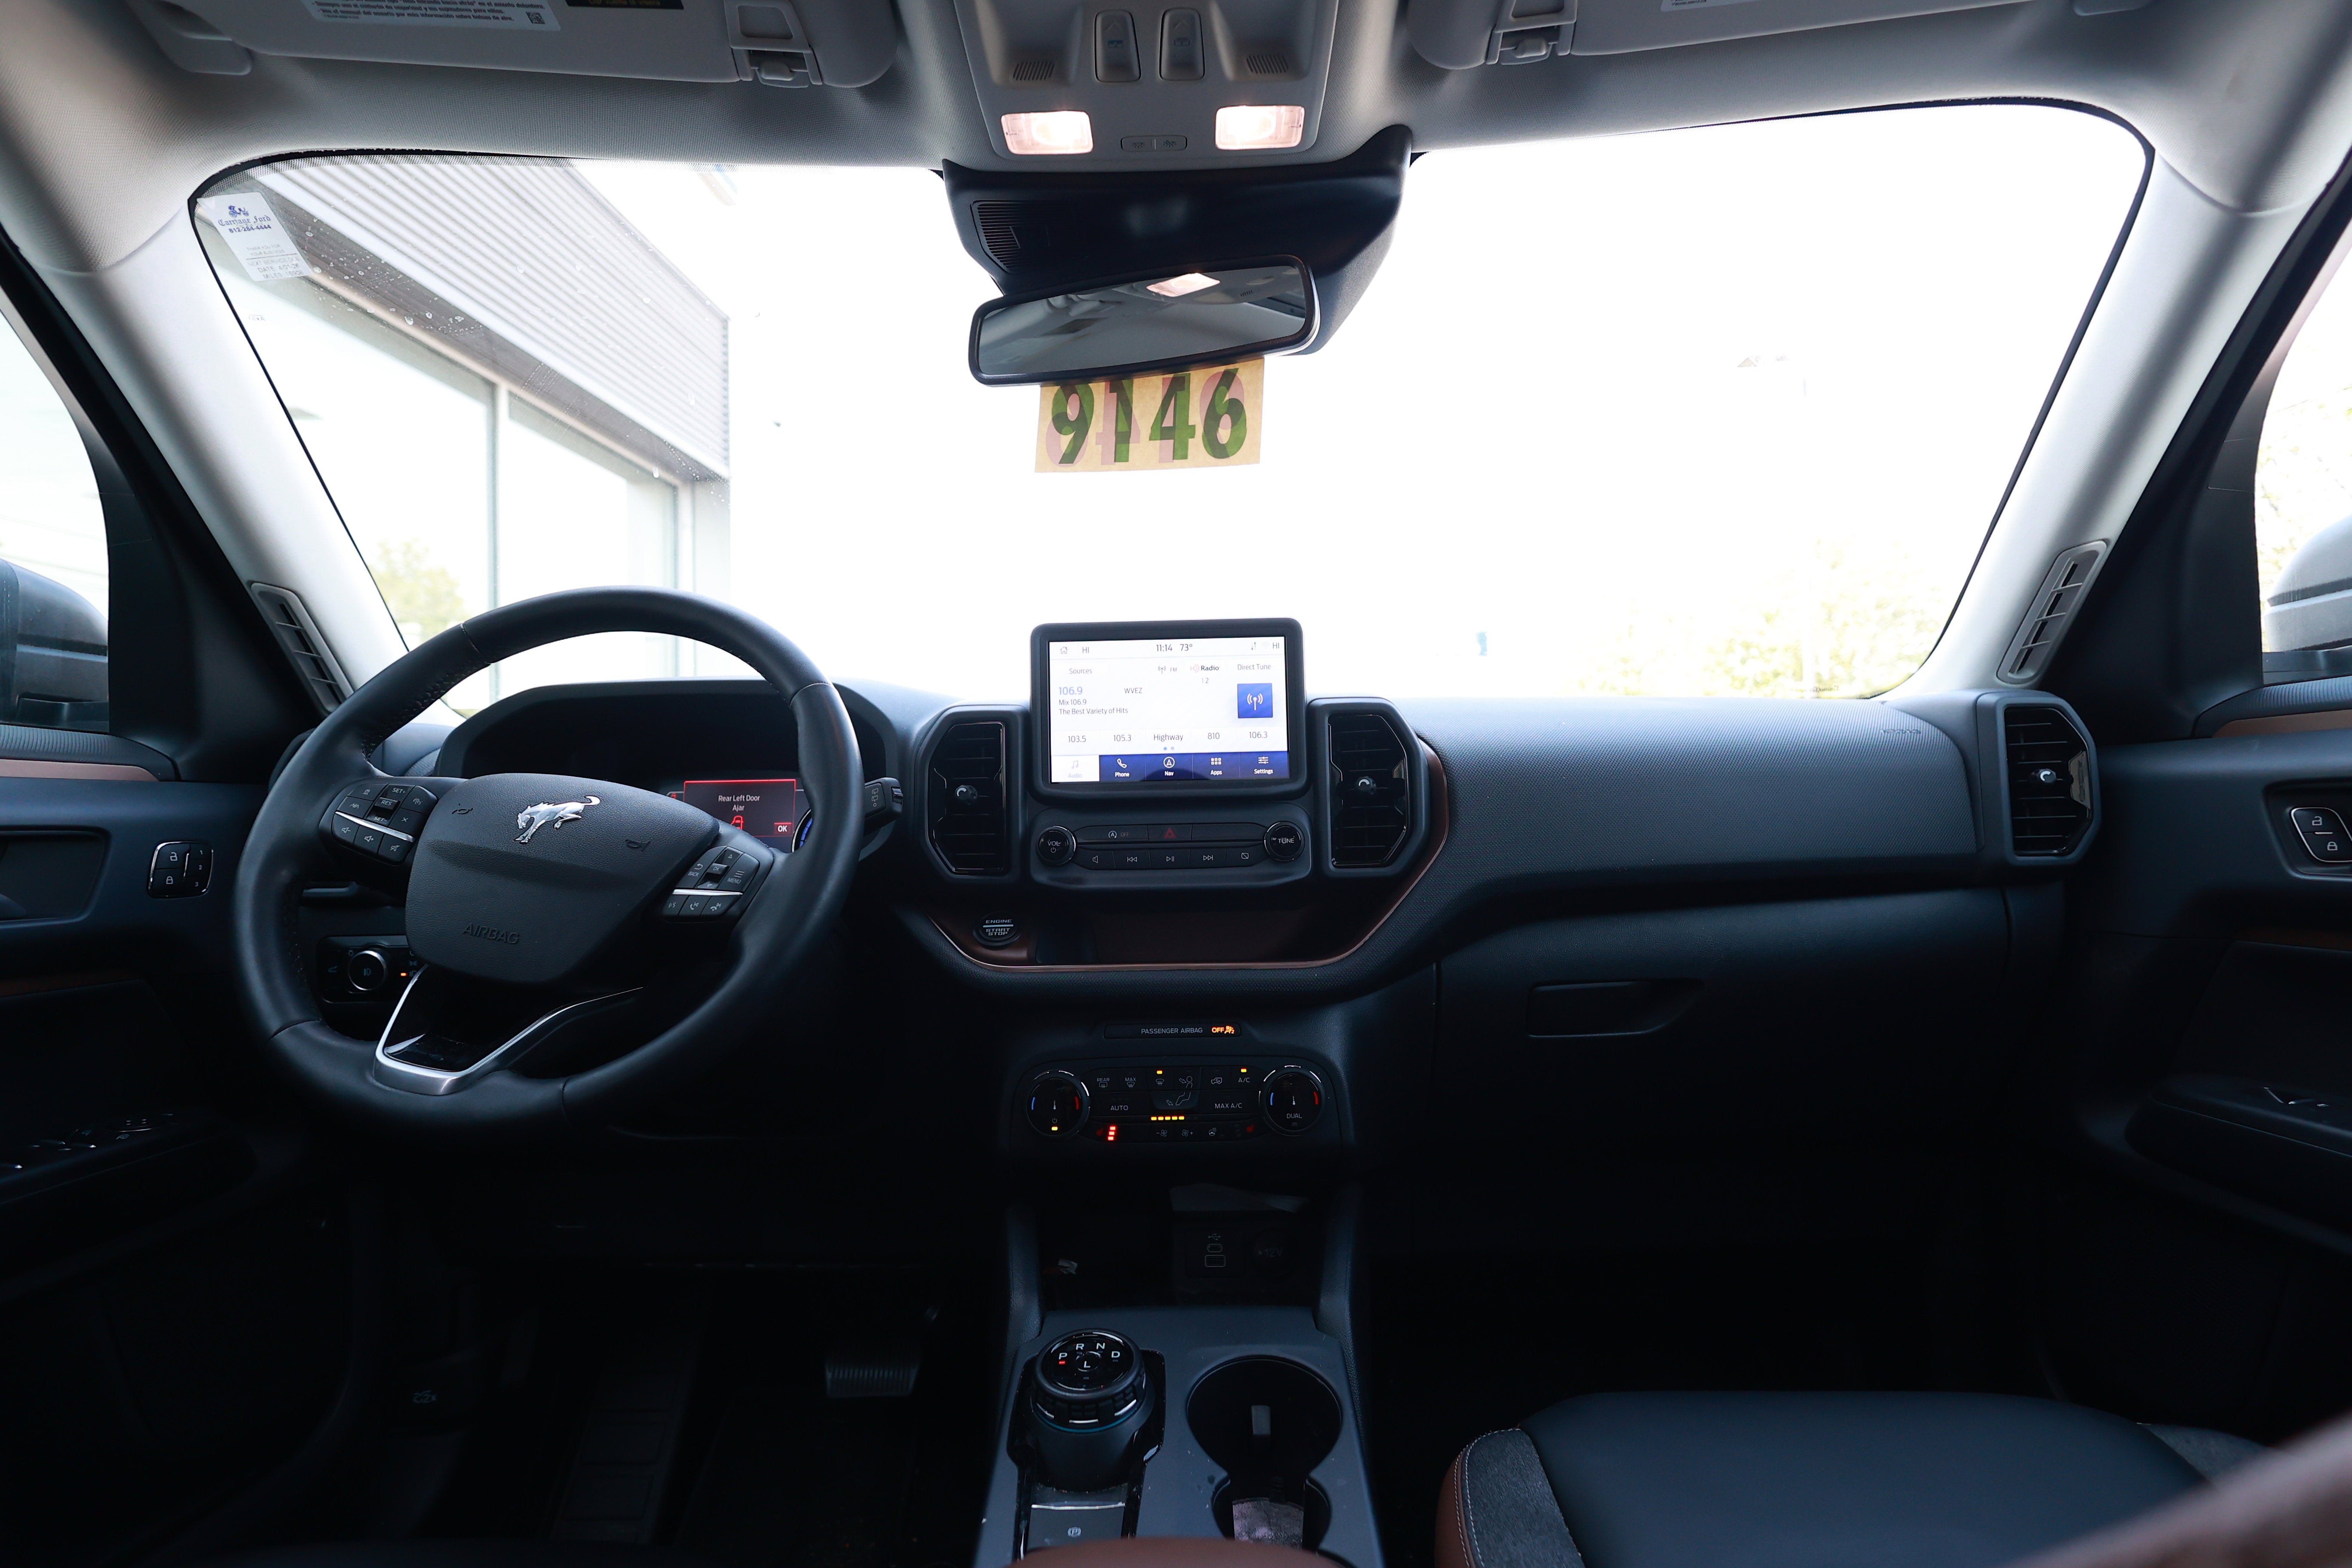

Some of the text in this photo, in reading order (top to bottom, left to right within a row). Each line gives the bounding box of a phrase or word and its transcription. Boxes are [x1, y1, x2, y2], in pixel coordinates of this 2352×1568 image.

[1052, 368, 1247, 464] 9146
[1059, 686, 1083, 695] 106.9
[1154, 733, 1183, 742] Highway
[463, 923, 521, 943] AIRBAG
[1264, 1246, 1283, 1257] 12V
